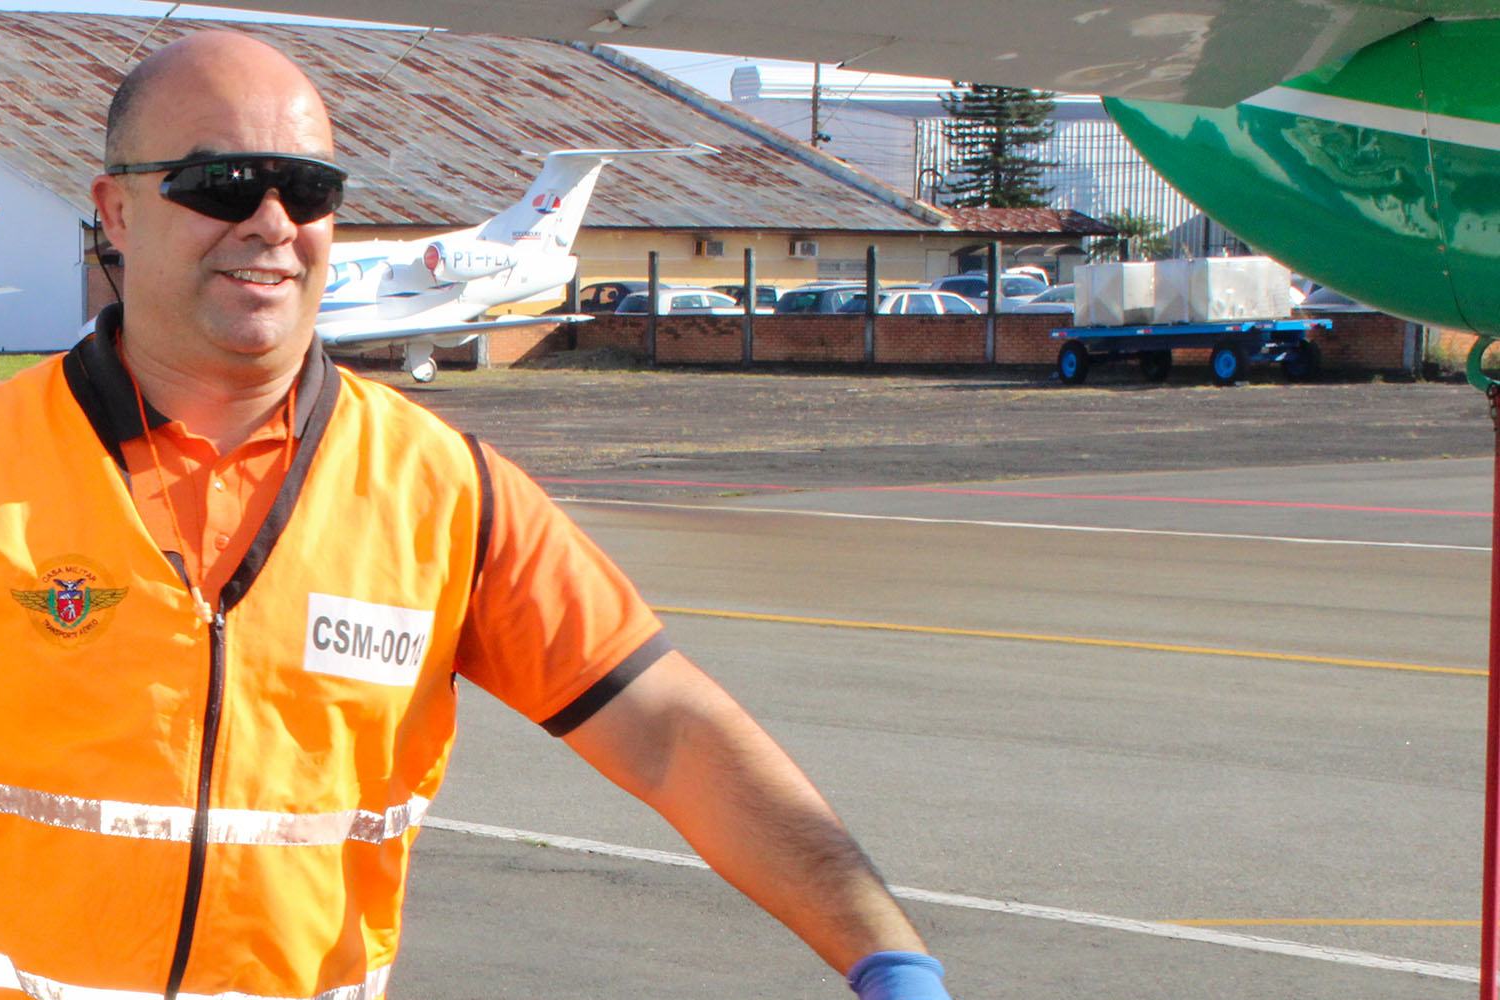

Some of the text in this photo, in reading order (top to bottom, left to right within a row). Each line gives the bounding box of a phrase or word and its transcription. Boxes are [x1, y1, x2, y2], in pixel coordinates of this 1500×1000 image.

[42, 566, 97, 583] CASA MILITAR
[43, 619, 78, 638] TRANSPORTE
